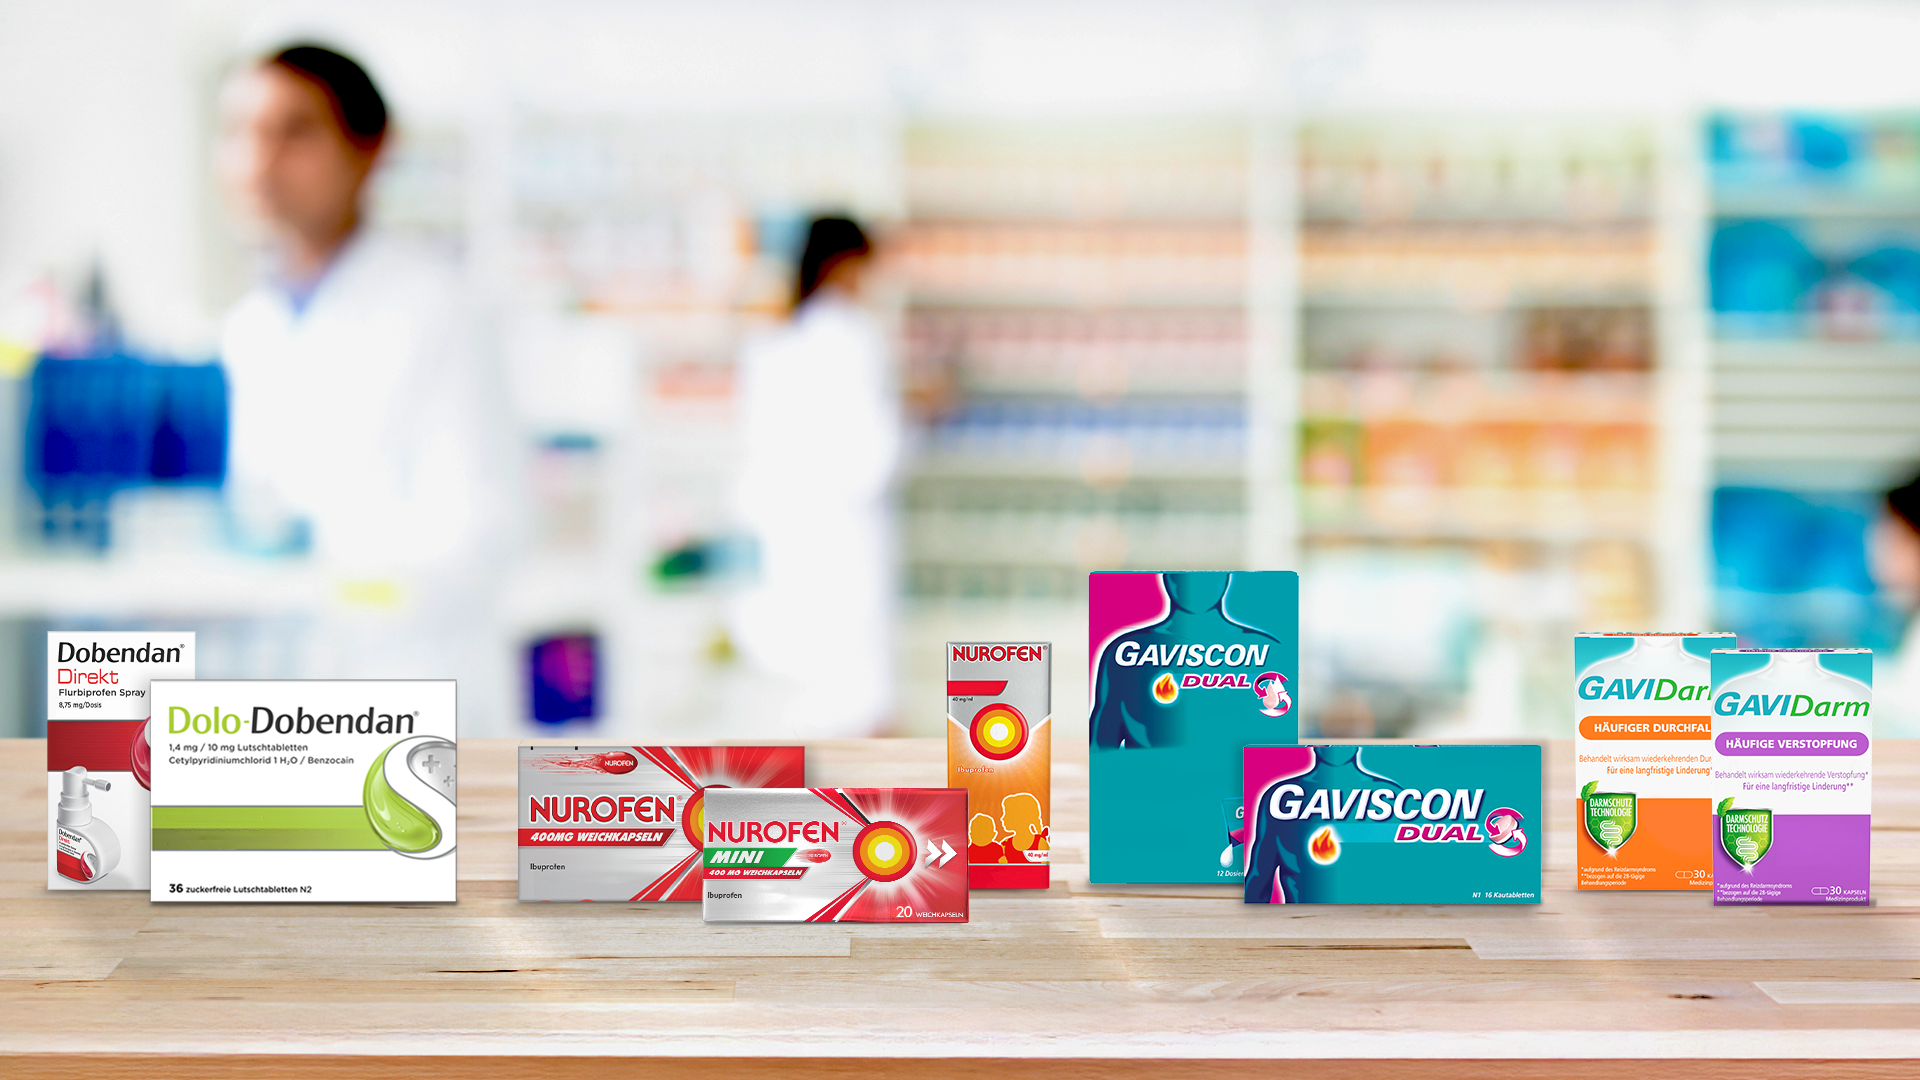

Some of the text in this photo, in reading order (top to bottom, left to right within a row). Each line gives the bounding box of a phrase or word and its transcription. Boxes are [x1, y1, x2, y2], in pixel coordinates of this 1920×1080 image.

[1115, 640, 1270, 668] GAVISCON
[57, 668, 119, 684] Direkt
[1182, 674, 1250, 688] DUAL
[58, 688, 146, 698] Flurbiprofen Spray
[73, 701, 102, 709] mg/Dosis
[1714, 691, 1870, 717] GAVIDarm
[1594, 721, 1650, 733] HÄUFIGER
[169, 743, 181, 752] 1,4
[208, 743, 218, 751] 10
[237, 743, 308, 751] Lutschtabletten
[1726, 738, 1857, 748] HÄUFIGE VERSTOPFUNG
[168, 756, 271, 765] Cetylpyridiniumchlorid
[307, 756, 354, 764] Benzocain
[1579, 754, 1612, 763] Behandelt
[1613, 754, 1640, 763] wirksam
[1641, 754, 1698, 763] wiederkehrenden
[957, 766, 995, 774] Ibuprofen
[1606, 766, 1618, 775] Für
[1619, 767, 1634, 775] eine
[1635, 765, 1674, 777] langfristige
[1715, 771, 1747, 779] Behandelt
[1775, 771, 1826, 779] wiederkehrende
[1742, 782, 1754, 791] Für
[1771, 782, 1811, 792] langfristige
[1269, 783, 1486, 821] GAVISCON
[1589, 798, 1632, 808] DARMSCHUTZ
[1590, 808, 1632, 817] TECHNOLOGIE
[1726, 815, 1768, 824] DARMSCHUTZ
[1396, 825, 1485, 842] DUAL
[1727, 824, 1768, 833] TECHNOLOGIE
[530, 832, 663, 842] 400MG WEICHKAPSELN
[710, 850, 764, 864] MINI
[530, 863, 566, 872] Ibuprofen
[1693, 869, 1705, 879] 30
[169, 883, 184, 893] 36
[185, 885, 231, 893] zuckerfreie
[233, 885, 298, 893] Lutschtabletten
[1829, 886, 1842, 895] 30
[707, 891, 743, 900] Ibuprofen
[1493, 891, 1535, 899] Kautabletten
[896, 905, 913, 918] 20
